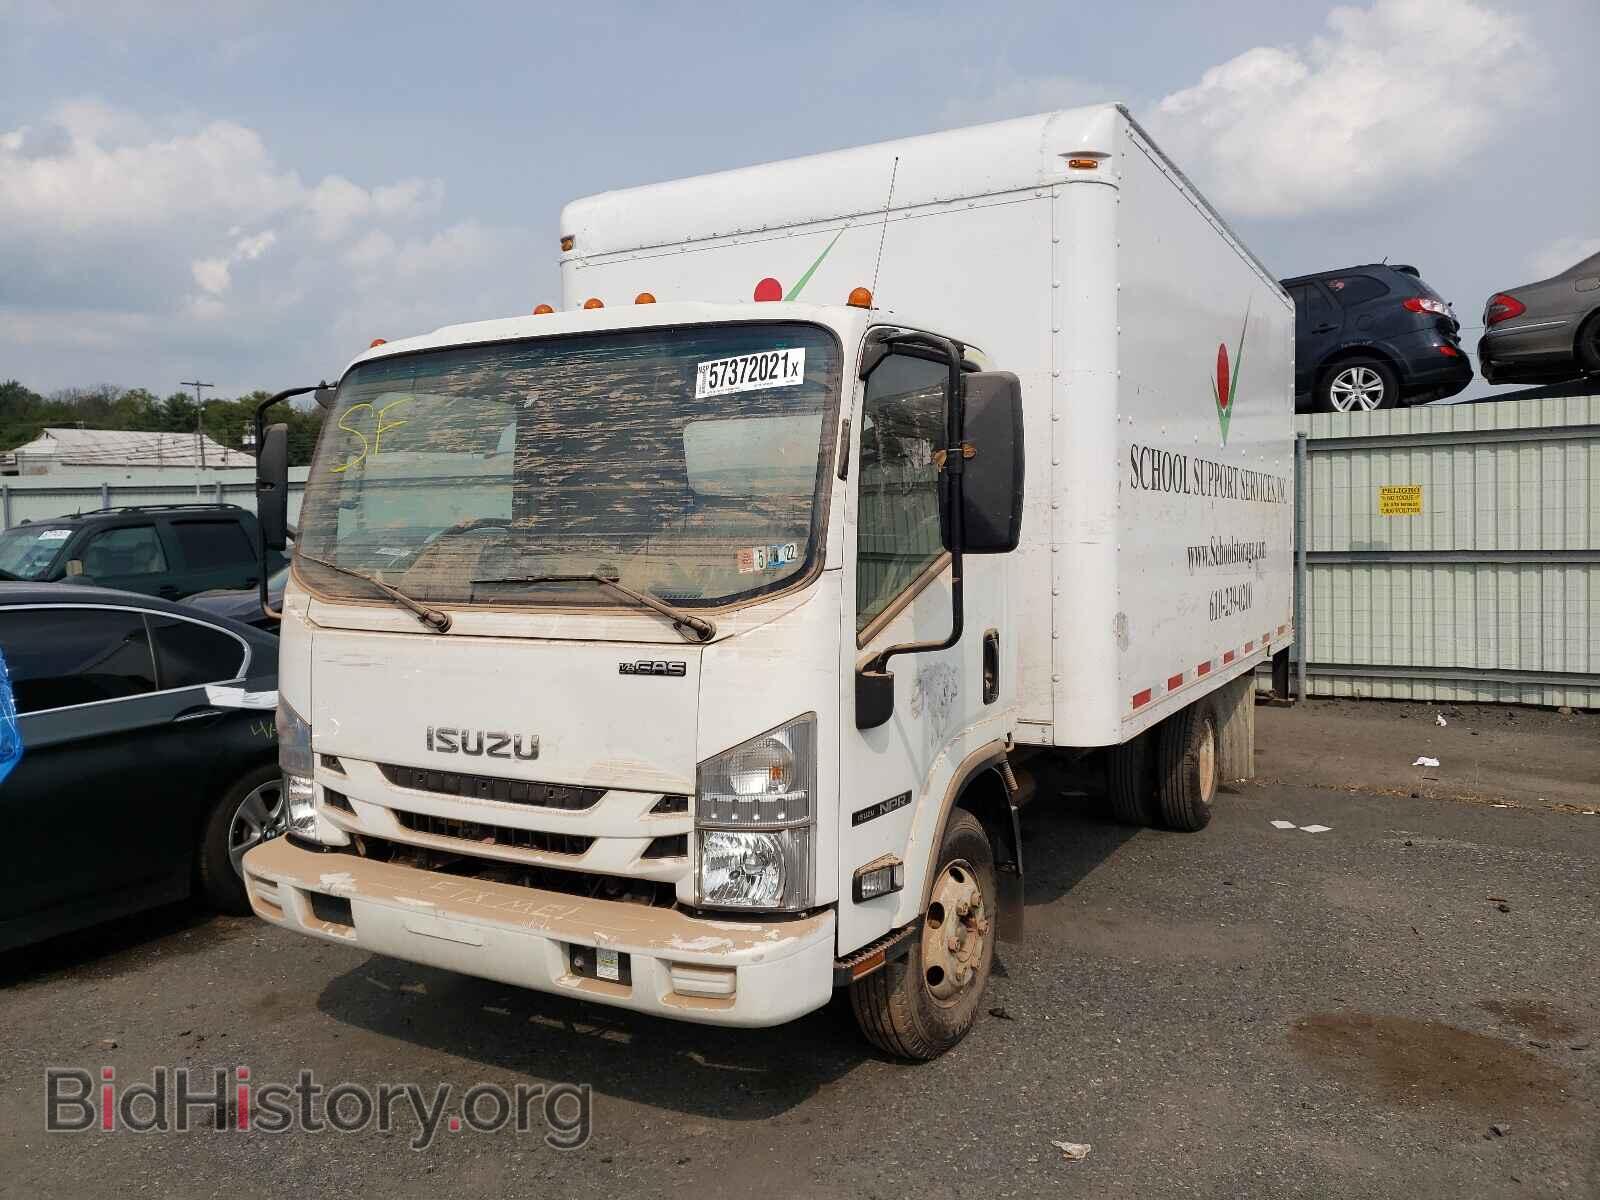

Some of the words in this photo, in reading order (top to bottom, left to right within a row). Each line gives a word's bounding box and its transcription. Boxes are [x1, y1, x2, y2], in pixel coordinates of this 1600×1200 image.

[709, 352, 790, 389] 57372021
[328, 397, 415, 473] SF
[1130, 443, 1190, 494] SCHOOL
[1193, 457, 1239, 500] SUPPORT
[757, 549, 764, 568] 5
[784, 544, 797, 561] 22
[1209, 583, 1253, 622] 610-239-0210
[426, 726, 540, 760] ISUZU
[879, 794, 907, 815] NPR
